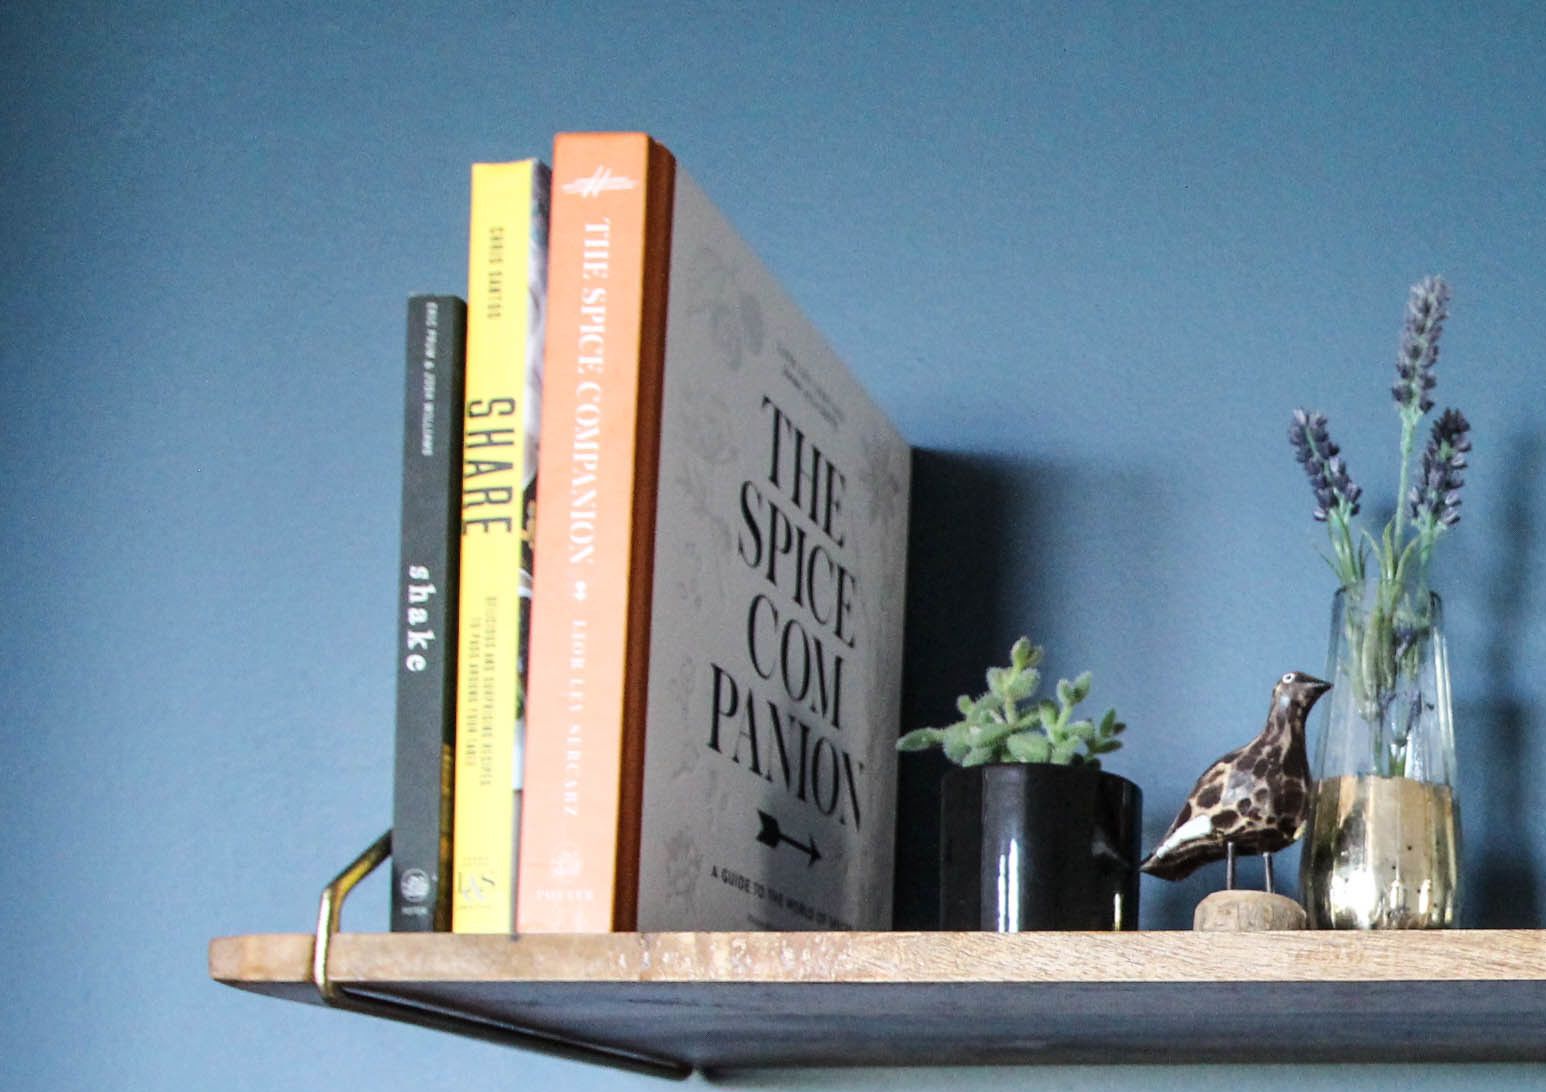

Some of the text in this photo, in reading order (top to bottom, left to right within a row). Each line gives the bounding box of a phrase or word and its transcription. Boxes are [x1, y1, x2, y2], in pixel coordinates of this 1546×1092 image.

[569, 217, 611, 564] THE SPICE COMPANION
[462, 398, 516, 536] SHARE
[761, 396, 846, 548] THE
[406, 565, 437, 672] shake
[738, 481, 855, 648] SPICE
[748, 594, 843, 730] COM
[707, 663, 864, 832] PANION
[710, 865, 719, 878] A
[721, 867, 751, 894] GUIDE
[753, 881, 765, 899] TO
